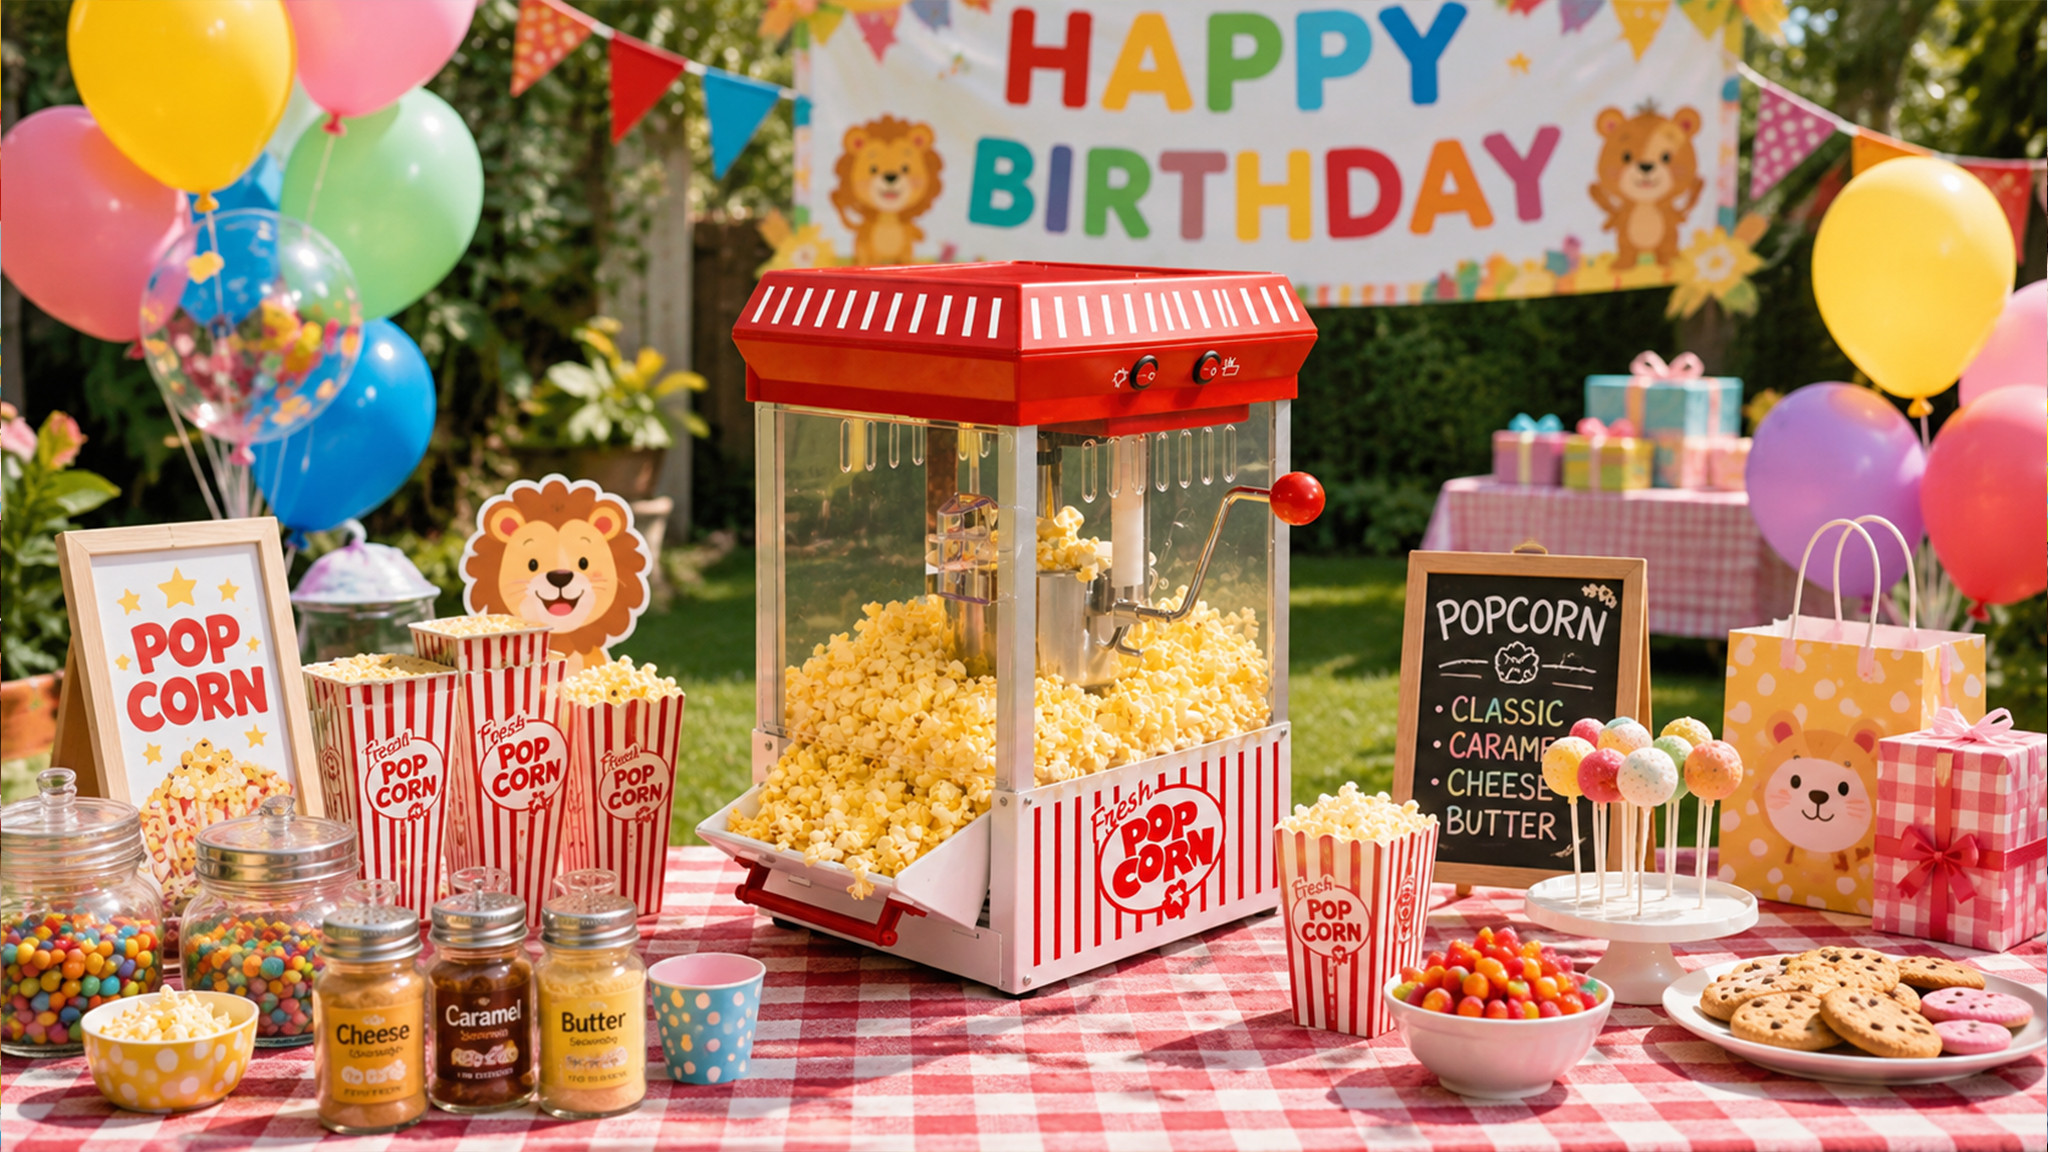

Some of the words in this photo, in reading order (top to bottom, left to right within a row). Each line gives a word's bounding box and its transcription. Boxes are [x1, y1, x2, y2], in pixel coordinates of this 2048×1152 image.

[1005, 1, 1468, 111] HAPPY
[966, 126, 1561, 241] BIRTHDAY
[1436, 596, 1608, 646] POPCORN
[131, 613, 240, 675] POP
[127, 666, 268, 732] CORN
[1451, 696, 1564, 727] CLASSIC
[498, 737, 550, 770] POP
[1449, 731, 1555, 762] CARAME
[381, 754, 428, 785] POP
[492, 758, 561, 797] CORN
[614, 764, 655, 789] POP
[1447, 768, 1553, 801] CHEESE
[376, 775, 436, 808] CORN
[608, 782, 662, 809] CORN
[1091, 779, 1153, 843] Fresh
[1446, 805, 1557, 841] BUTTER
[1121, 801, 1198, 858] POP
[1112, 827, 1215, 899] CORN
[1292, 875, 1333, 900] Fresh
[1307, 899, 1352, 920] POP
[1302, 922, 1362, 942] CORN
[446, 999, 521, 1027] Caramel
[562, 1012, 626, 1033] Butter
[336, 1024, 410, 1045] Cheese
